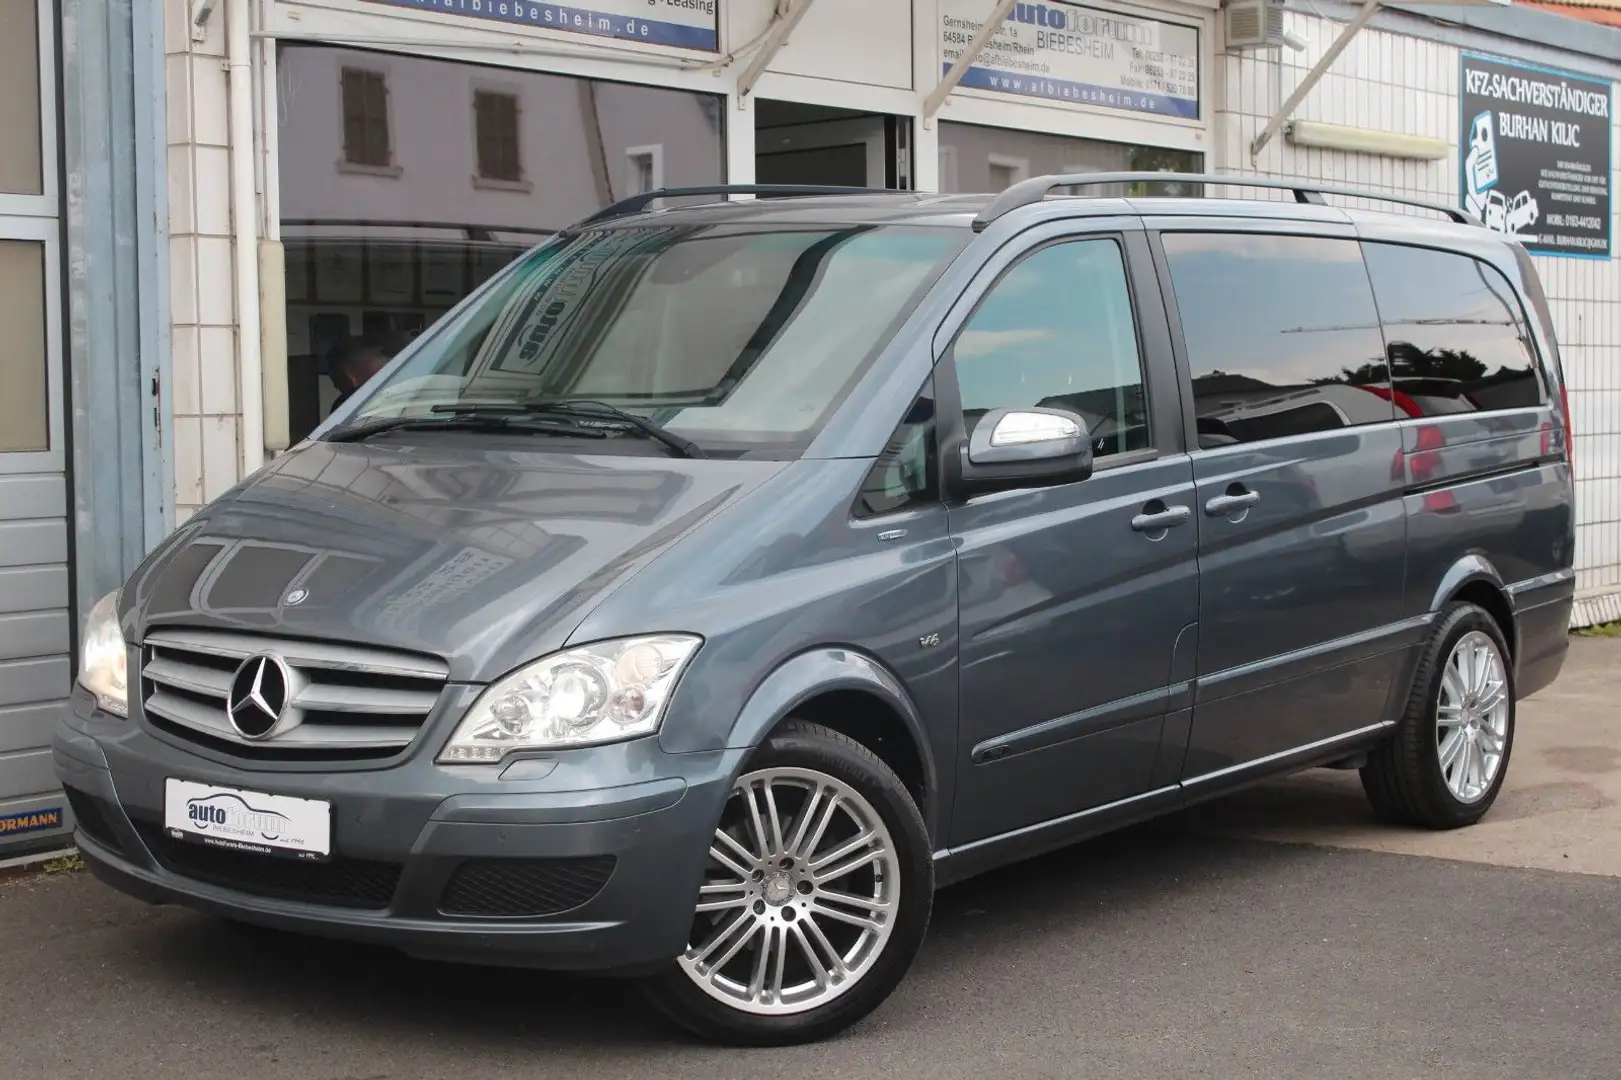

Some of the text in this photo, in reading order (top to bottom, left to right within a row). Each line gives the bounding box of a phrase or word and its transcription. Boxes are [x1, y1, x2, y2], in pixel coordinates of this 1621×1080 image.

[943, 31, 965, 44] 64584
[1006, 3, 1152, 46] utoforum
[1037, 30, 1114, 60] BIEBESHEIM
[989, 76, 1156, 110] www.afbiebesheim.de
[1465, 69, 1608, 118] KFZ-SACHVERSTÄNDIGER
[1499, 112, 1580, 147] BURHAN KILIC
